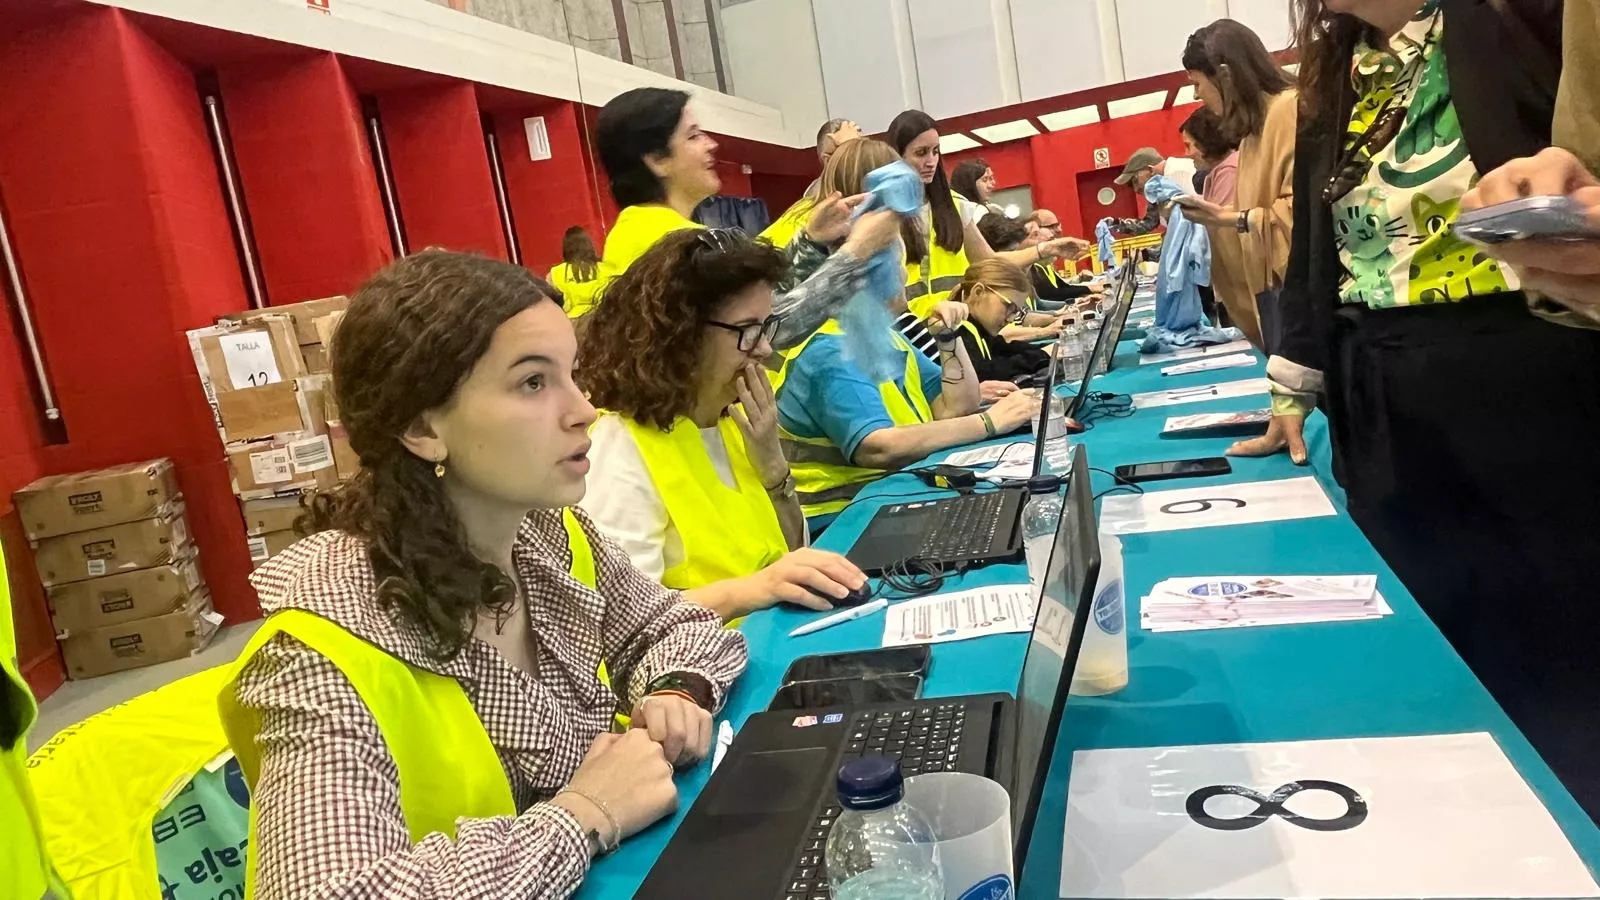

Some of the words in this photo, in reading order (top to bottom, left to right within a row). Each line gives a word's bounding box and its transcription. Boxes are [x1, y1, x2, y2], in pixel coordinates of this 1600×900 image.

[235, 341, 261, 352] TALLA
[247, 371, 269, 387] 12
[1185, 779, 1369, 832] 8
